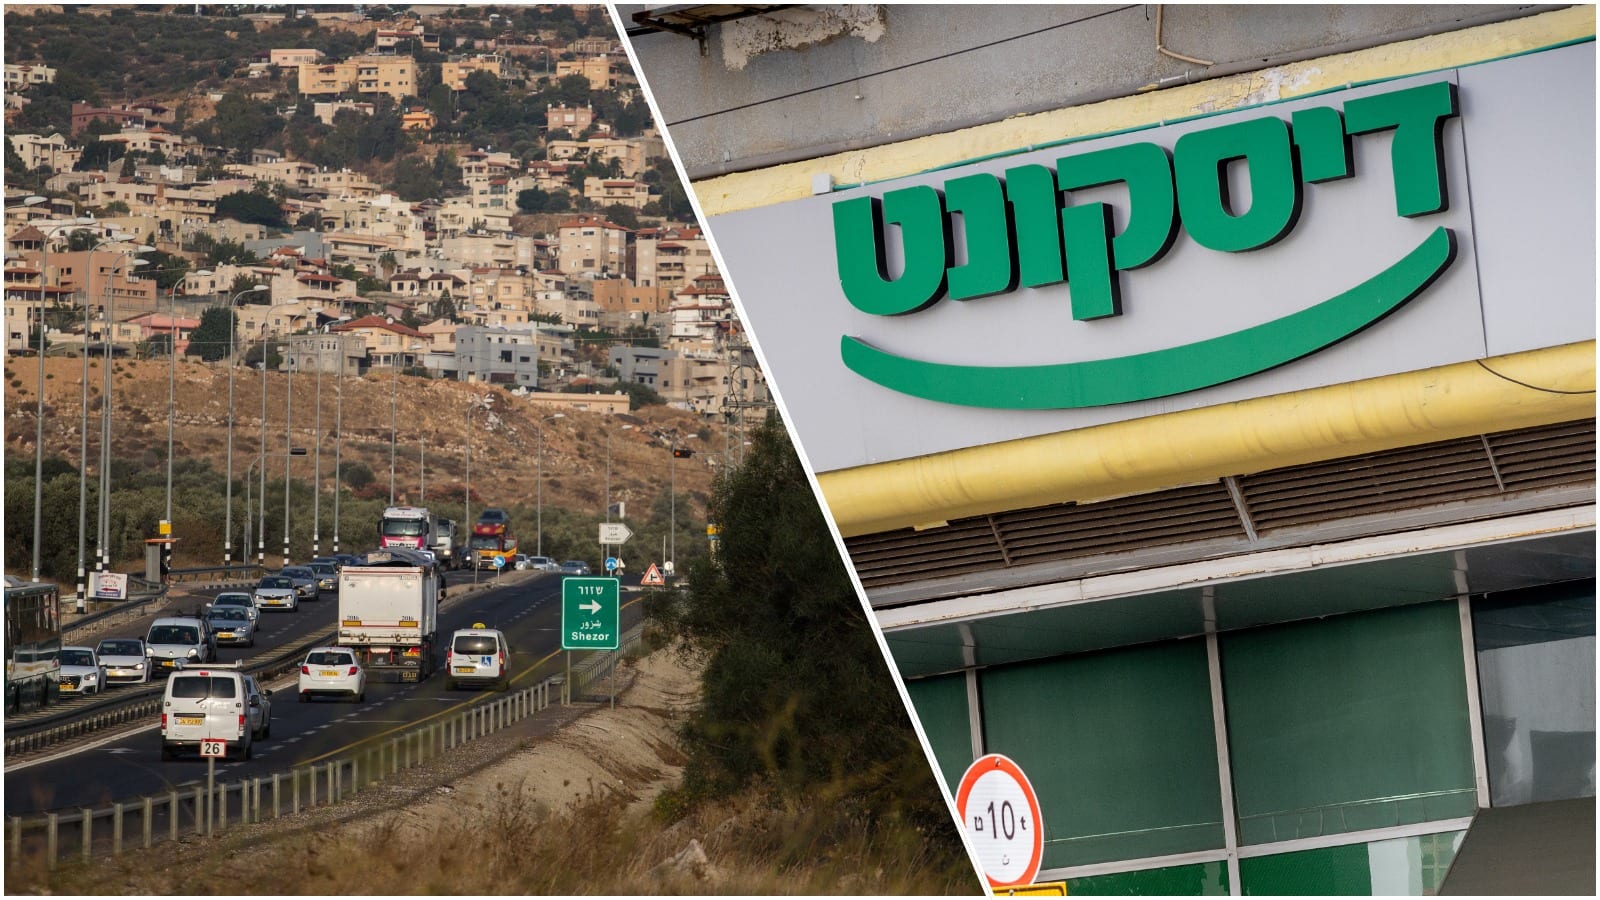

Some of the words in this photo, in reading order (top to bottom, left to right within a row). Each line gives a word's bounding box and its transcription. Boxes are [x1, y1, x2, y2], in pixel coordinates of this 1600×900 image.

[833, 81, 1459, 320] דיסקונט
[578, 586, 603, 594] שזור
[580, 620, 601, 630] شزور
[571, 632, 609, 640] Shezor
[205, 743, 220, 754] 26
[974, 816, 984, 831] ט
[988, 801, 1015, 840] 10
[1020, 816, 1026, 830] t
